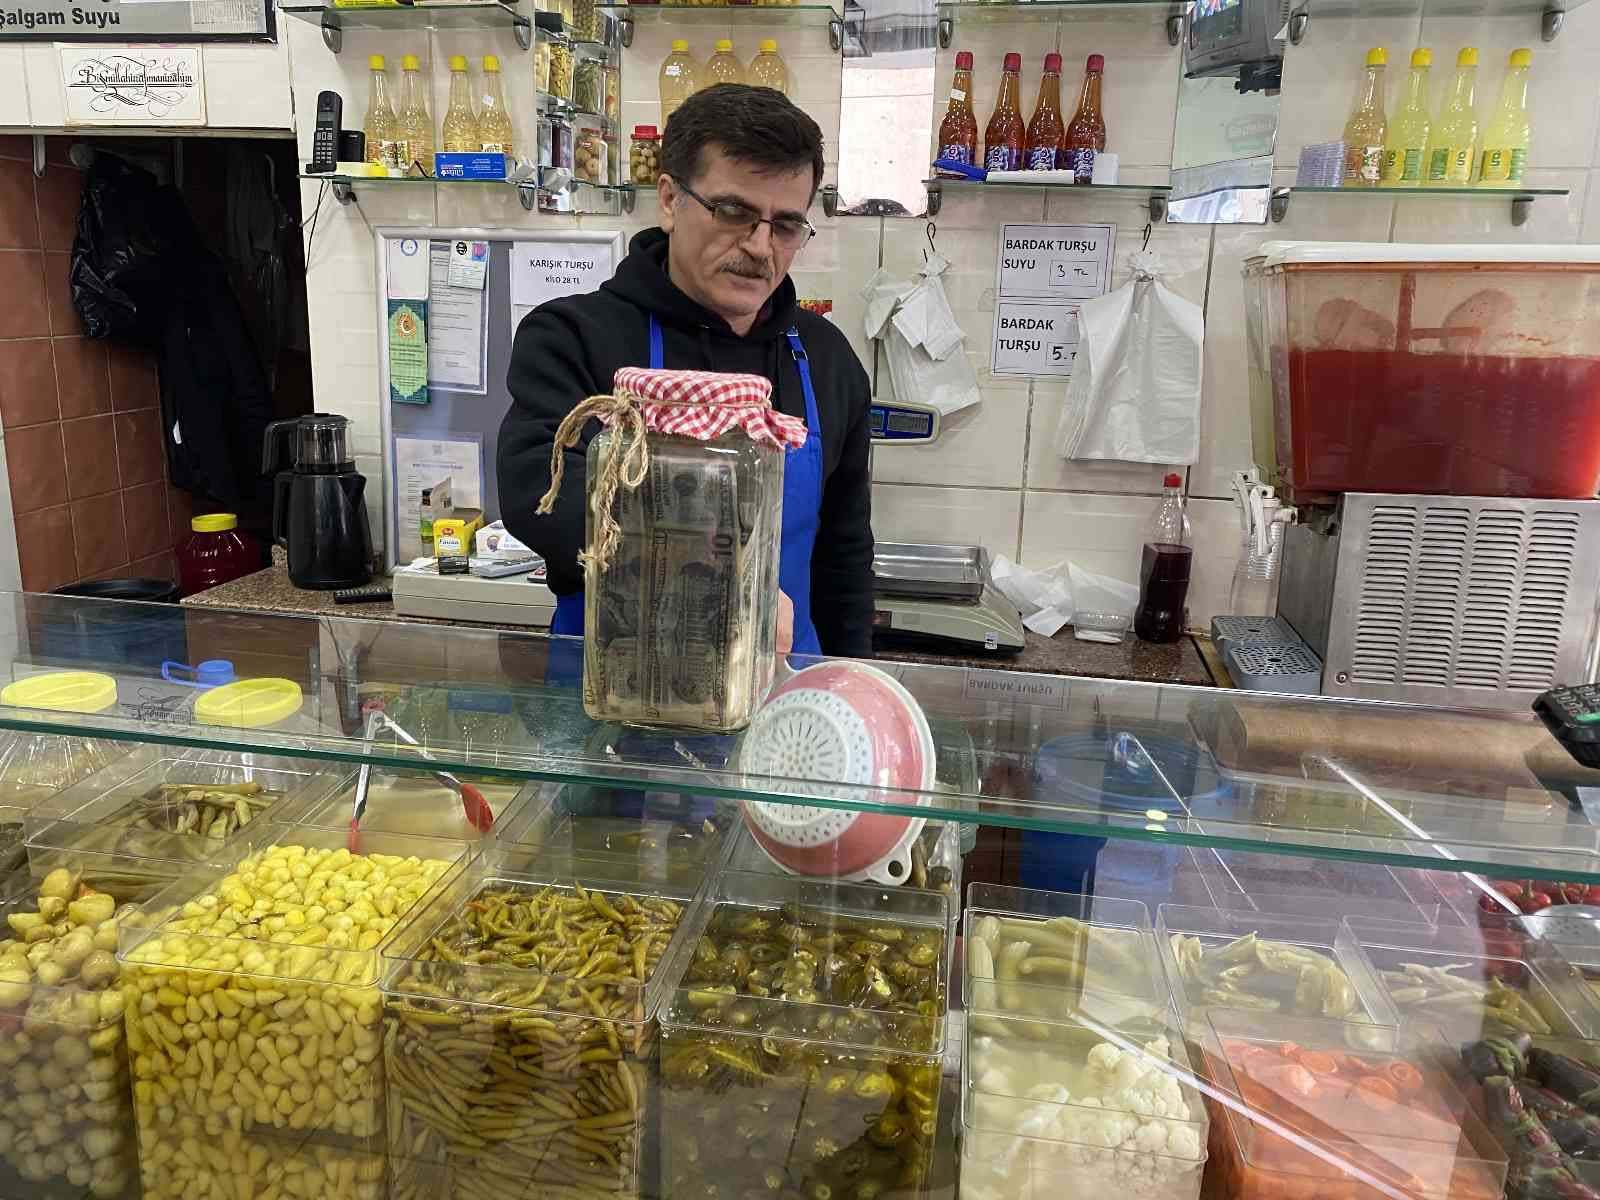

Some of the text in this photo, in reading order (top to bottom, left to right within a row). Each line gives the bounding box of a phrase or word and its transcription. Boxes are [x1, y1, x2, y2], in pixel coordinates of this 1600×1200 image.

[72, 7, 121, 29] Suyu
[1006, 239, 1097, 254] BARDAK TURŞU
[529, 259, 594, 271] KARIŞIK TURŞU
[1004, 258, 1036, 269] SUYU
[1057, 264, 1066, 278] 3
[1001, 318, 1054, 331] BARDAK
[999, 339, 1041, 353] TURŞU
